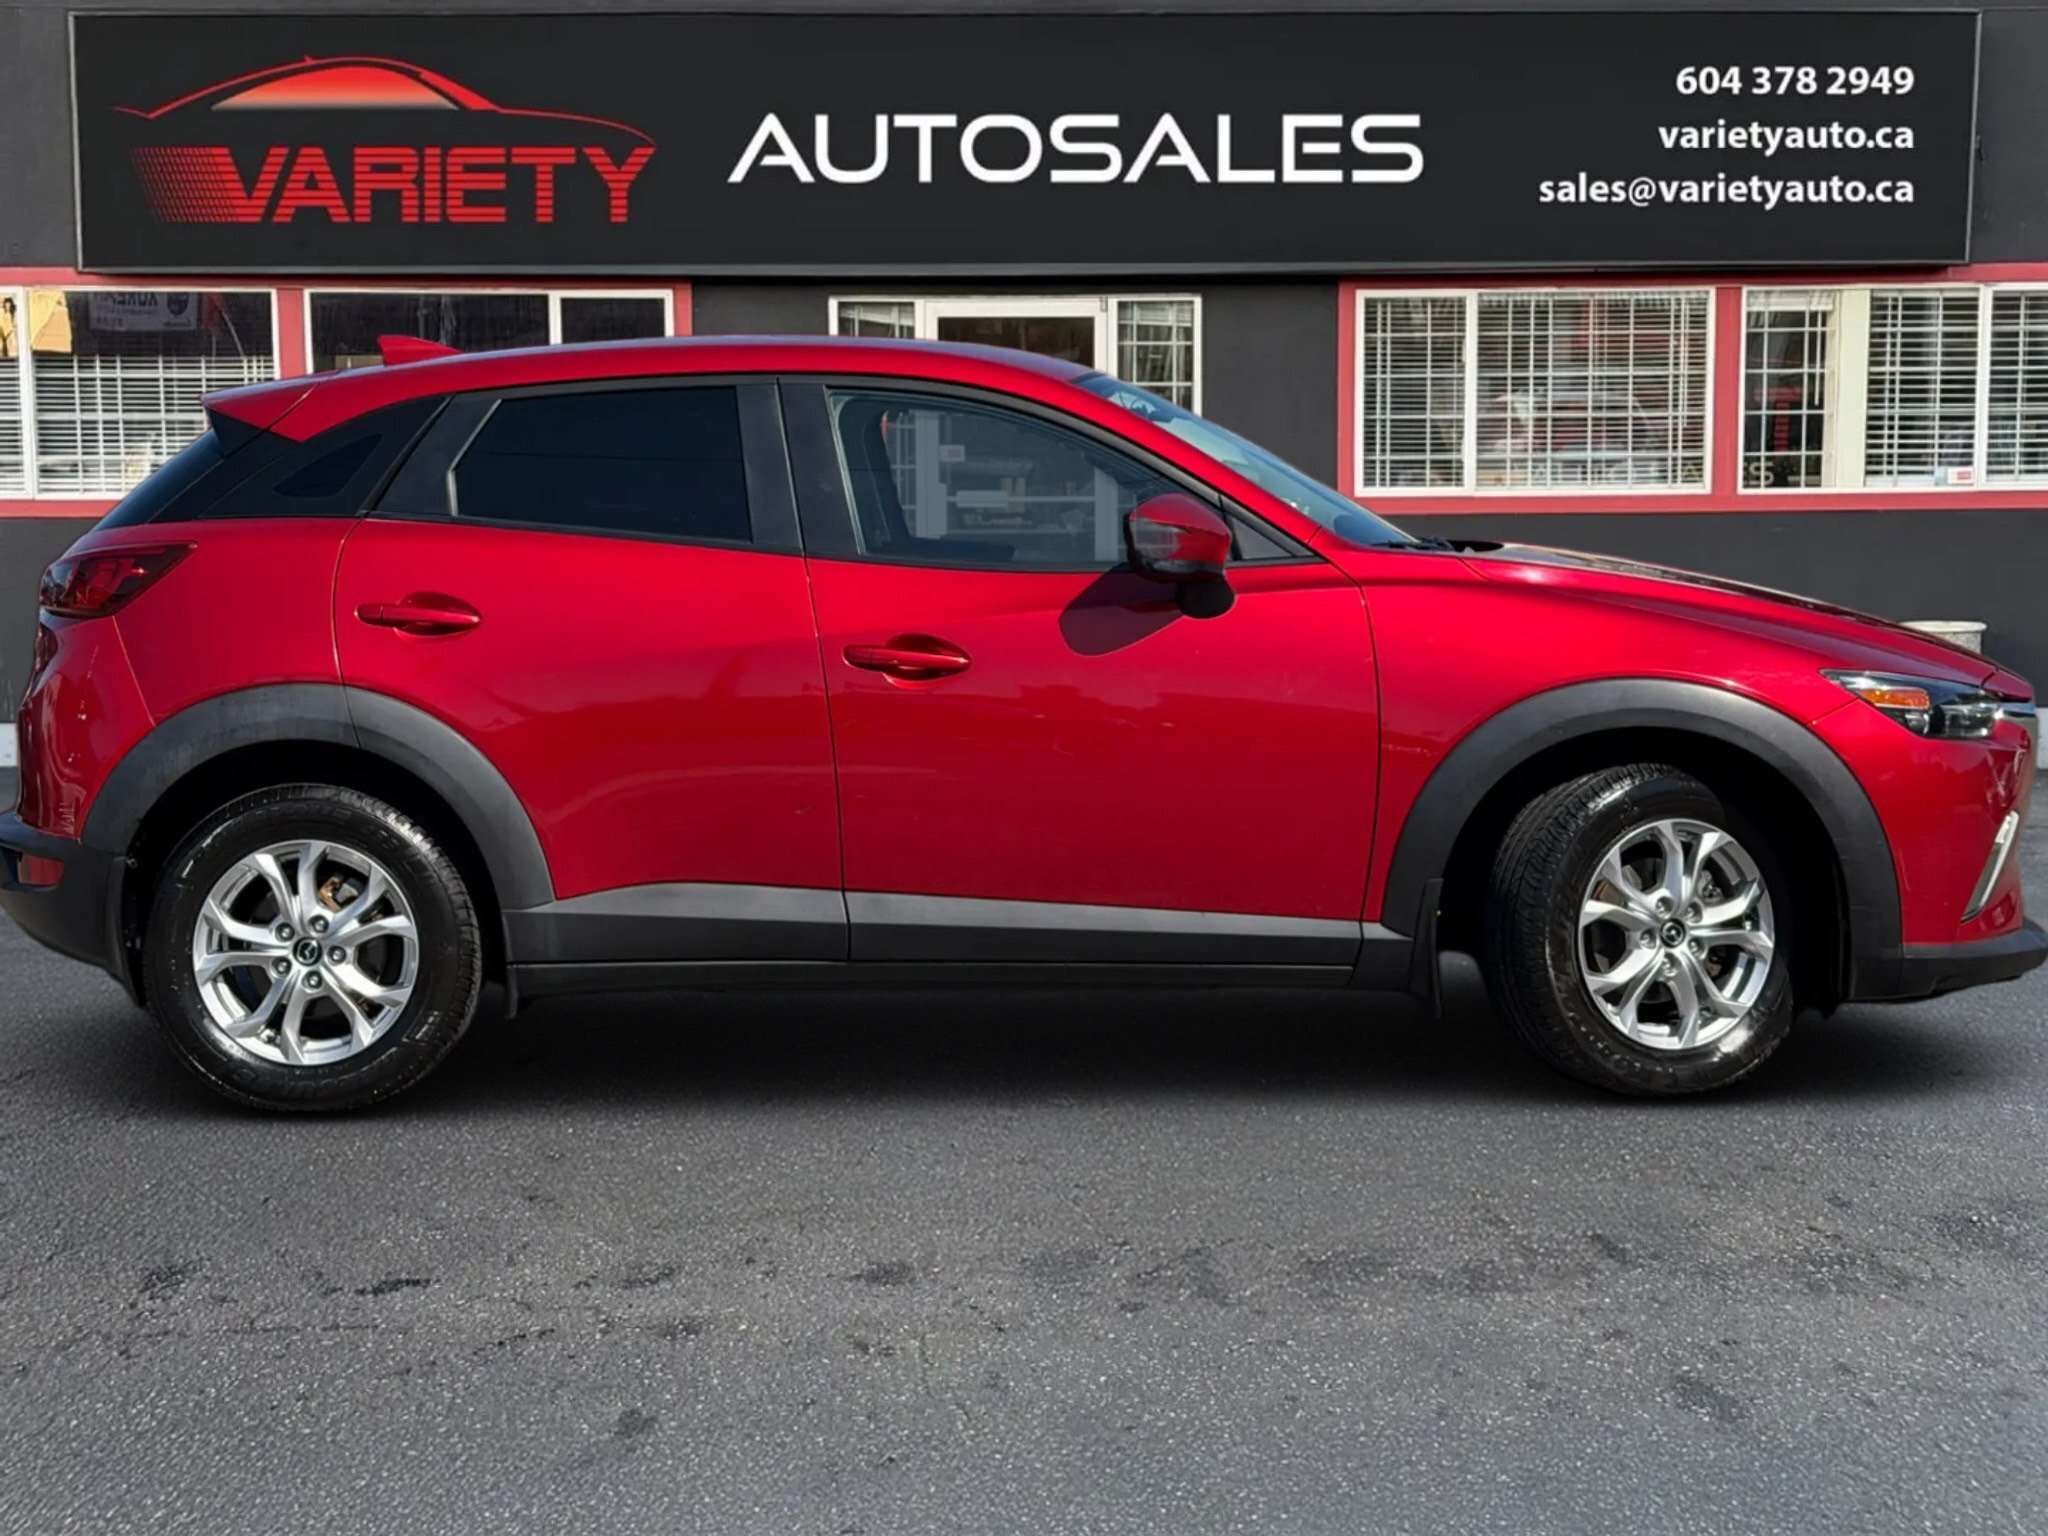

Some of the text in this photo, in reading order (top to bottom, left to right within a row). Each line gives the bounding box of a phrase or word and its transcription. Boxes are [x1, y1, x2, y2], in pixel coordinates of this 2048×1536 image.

[1675, 65, 1915, 96] 604 378 2949
[727, 112, 1424, 184] AUTOSALES
[1658, 118, 1915, 157] varietyauto.ca
[134, 145, 656, 224] VARIETY
[1538, 171, 1915, 211] sales@varietyauto.ca
